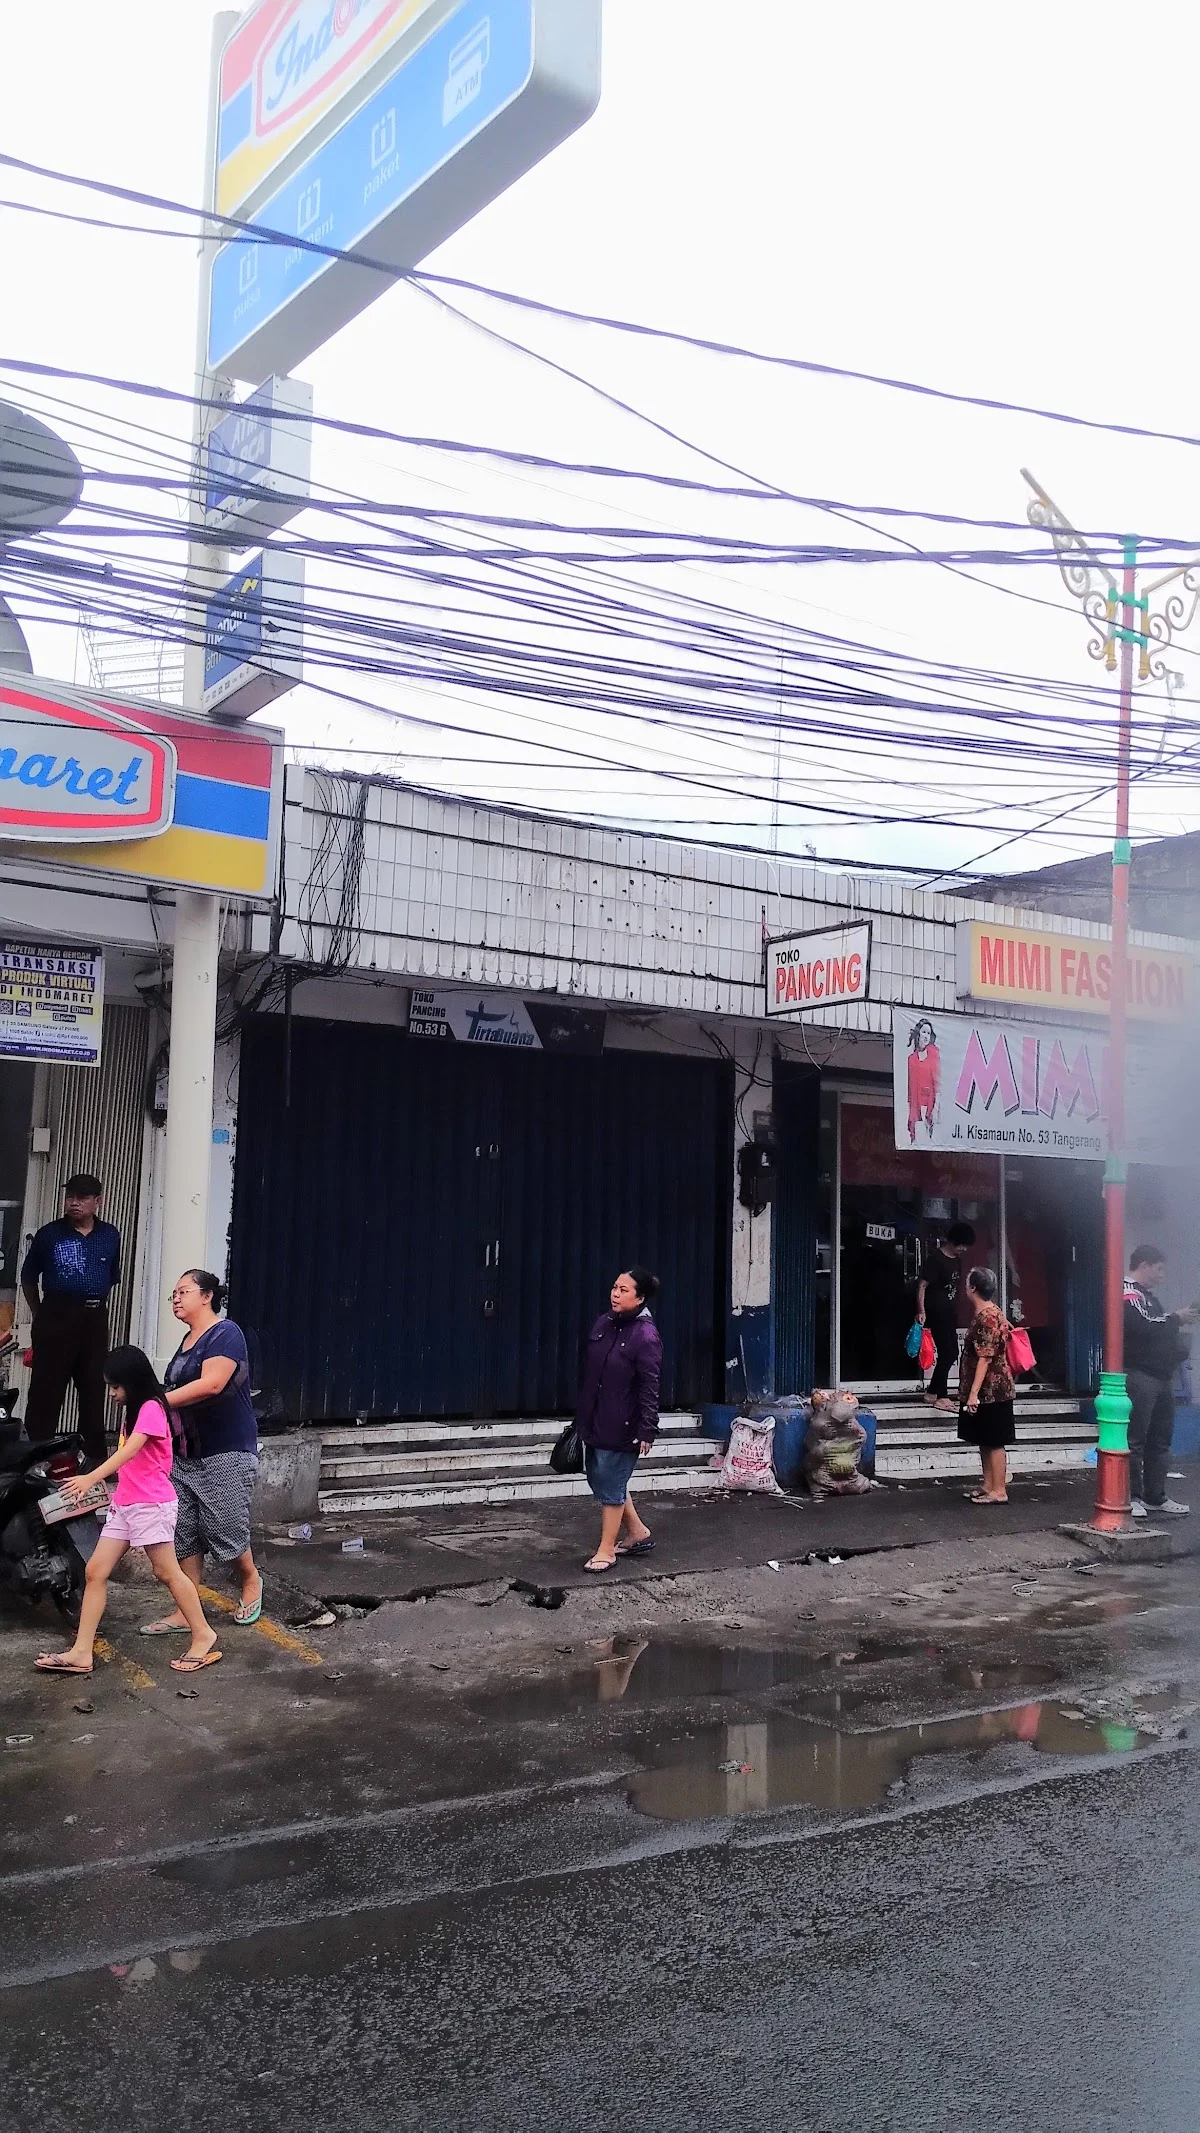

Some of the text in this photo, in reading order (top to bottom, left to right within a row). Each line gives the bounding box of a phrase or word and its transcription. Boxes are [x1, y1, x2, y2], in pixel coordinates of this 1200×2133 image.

[455, 71, 479, 105] ATM
[2, 954, 94, 976] TRANSAKSI
[775, 949, 800, 965] TOKO
[980, 936, 1053, 992] MIMI
[1, 969, 94, 991] PRODUK VIRTUAL
[776, 953, 862, 1004] PANCING
[1, 985, 94, 1004] DI INDOMARET
[414, 991, 434, 1004] TOKO
[411, 1005, 446, 1018] PANCING
[440, 1024, 447, 1036] B
[952, 1124, 963, 1139] Jl.
[967, 1124, 1015, 1142] Kisamaun
[1018, 1128, 1036, 1143] No.
[1038, 1130, 1050, 1145] 53
[869, 1226, 892, 1238] BUKA
